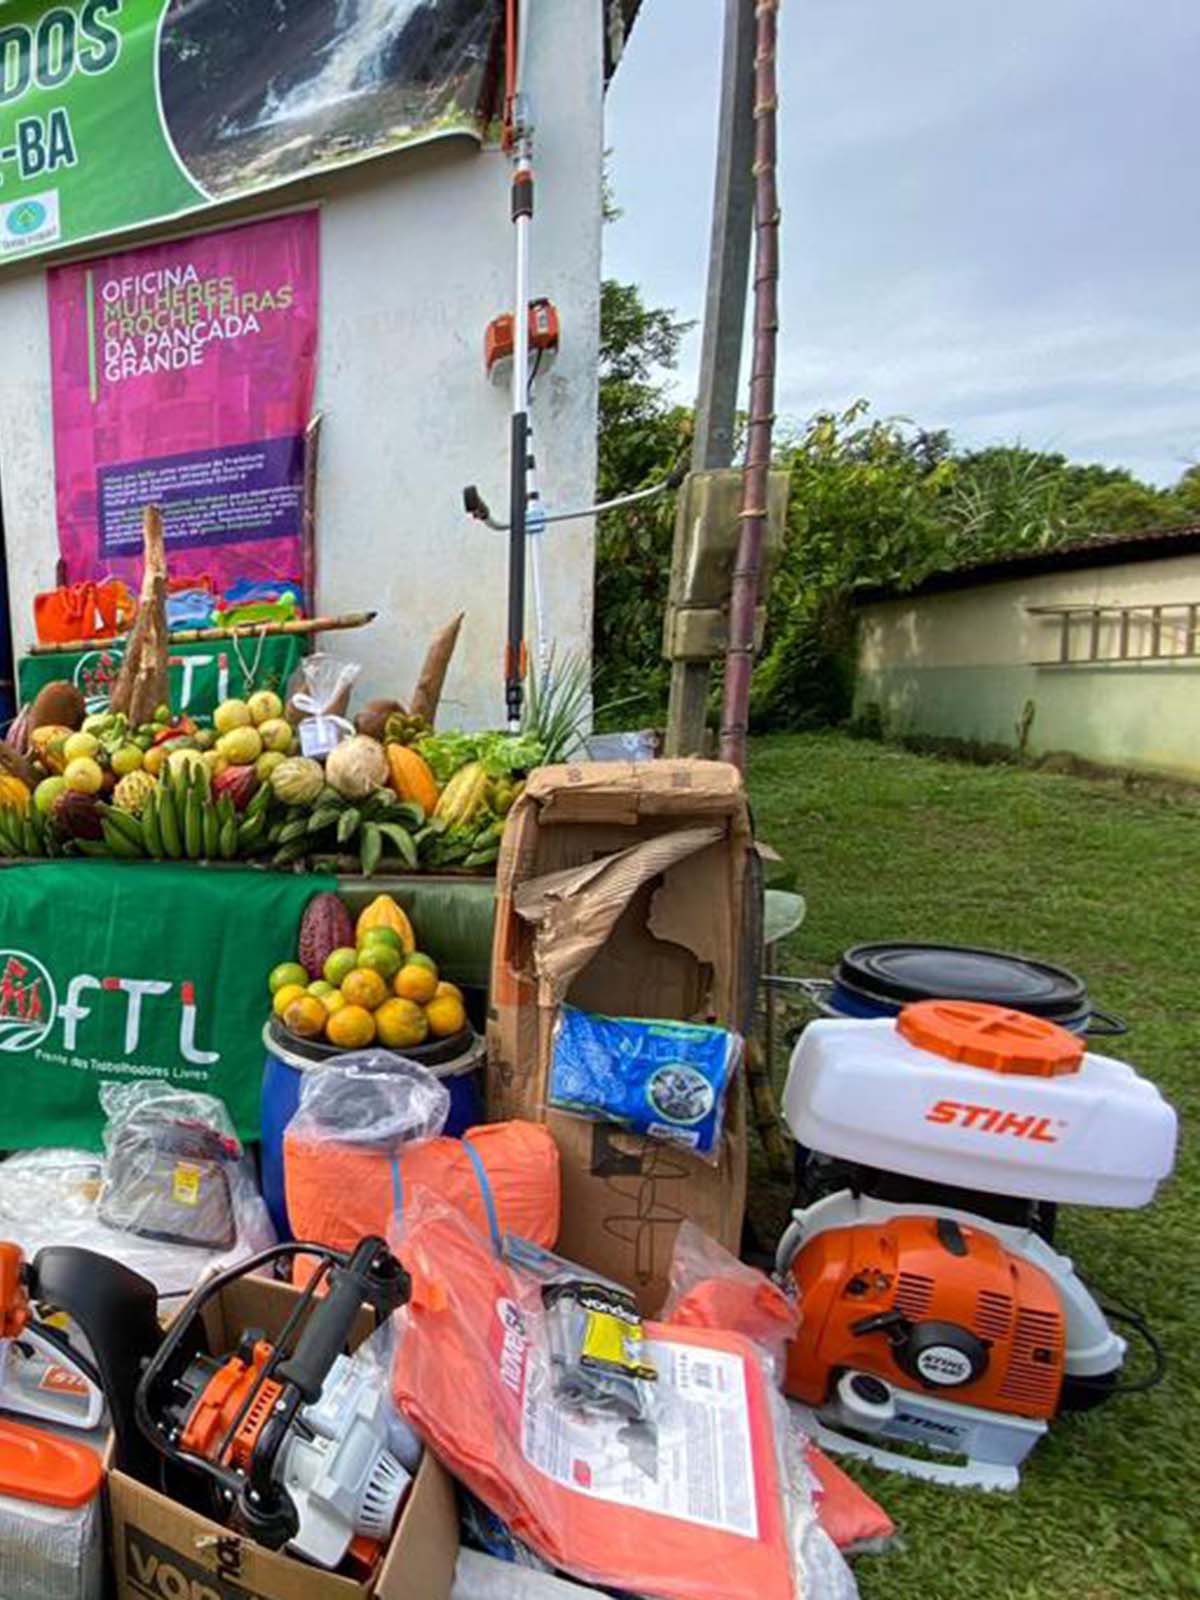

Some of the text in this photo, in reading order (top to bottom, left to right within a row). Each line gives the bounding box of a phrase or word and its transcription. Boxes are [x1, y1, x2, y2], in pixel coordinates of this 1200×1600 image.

[102, 263, 199, 303] OFICINA
[103, 276, 234, 322] MULHERES
[103, 285, 294, 342] CROCHETEIRAS
[104, 337, 138, 363] DA
[104, 344, 204, 382] GRANDE
[924, 1099, 1057, 1144] STIHL
